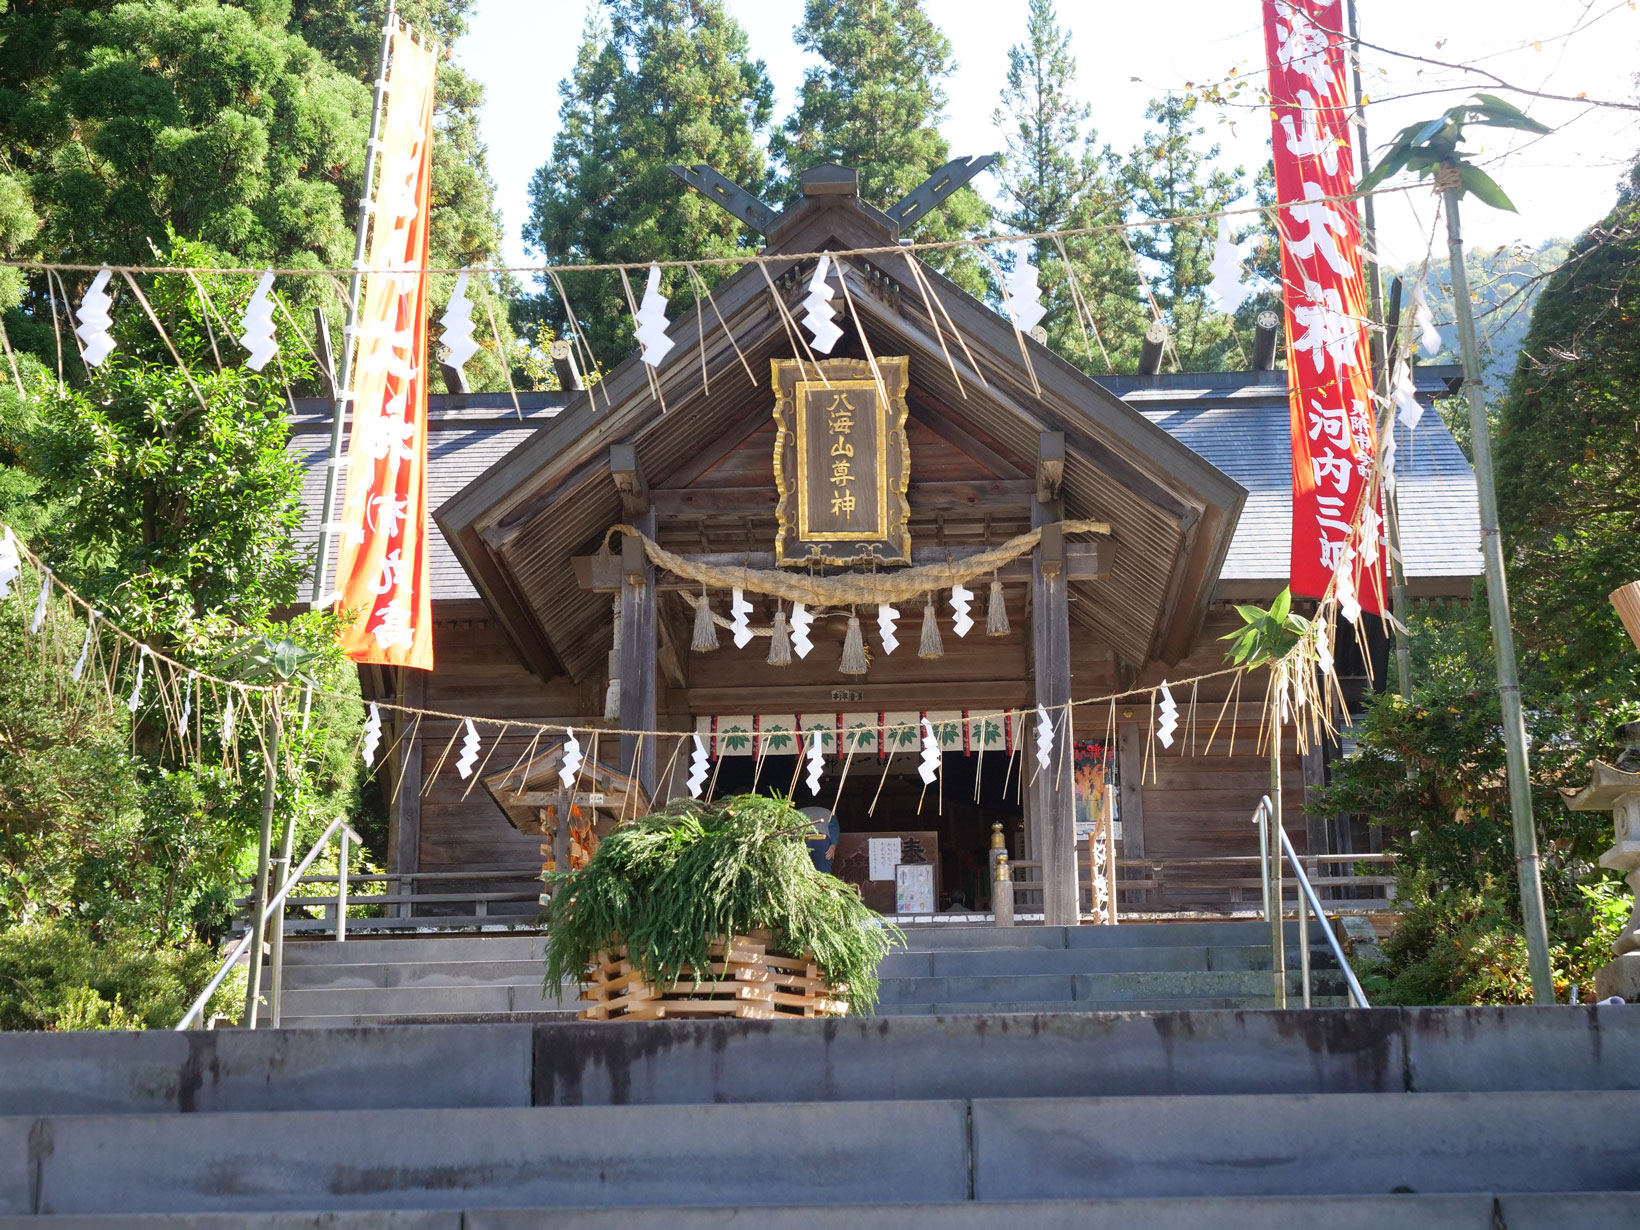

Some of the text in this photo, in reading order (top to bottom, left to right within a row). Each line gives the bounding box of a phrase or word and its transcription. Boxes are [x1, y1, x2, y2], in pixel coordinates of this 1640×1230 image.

[1274, 0, 1360, 386] 海山大神
[826, 393, 856, 521] 八海山尊神
